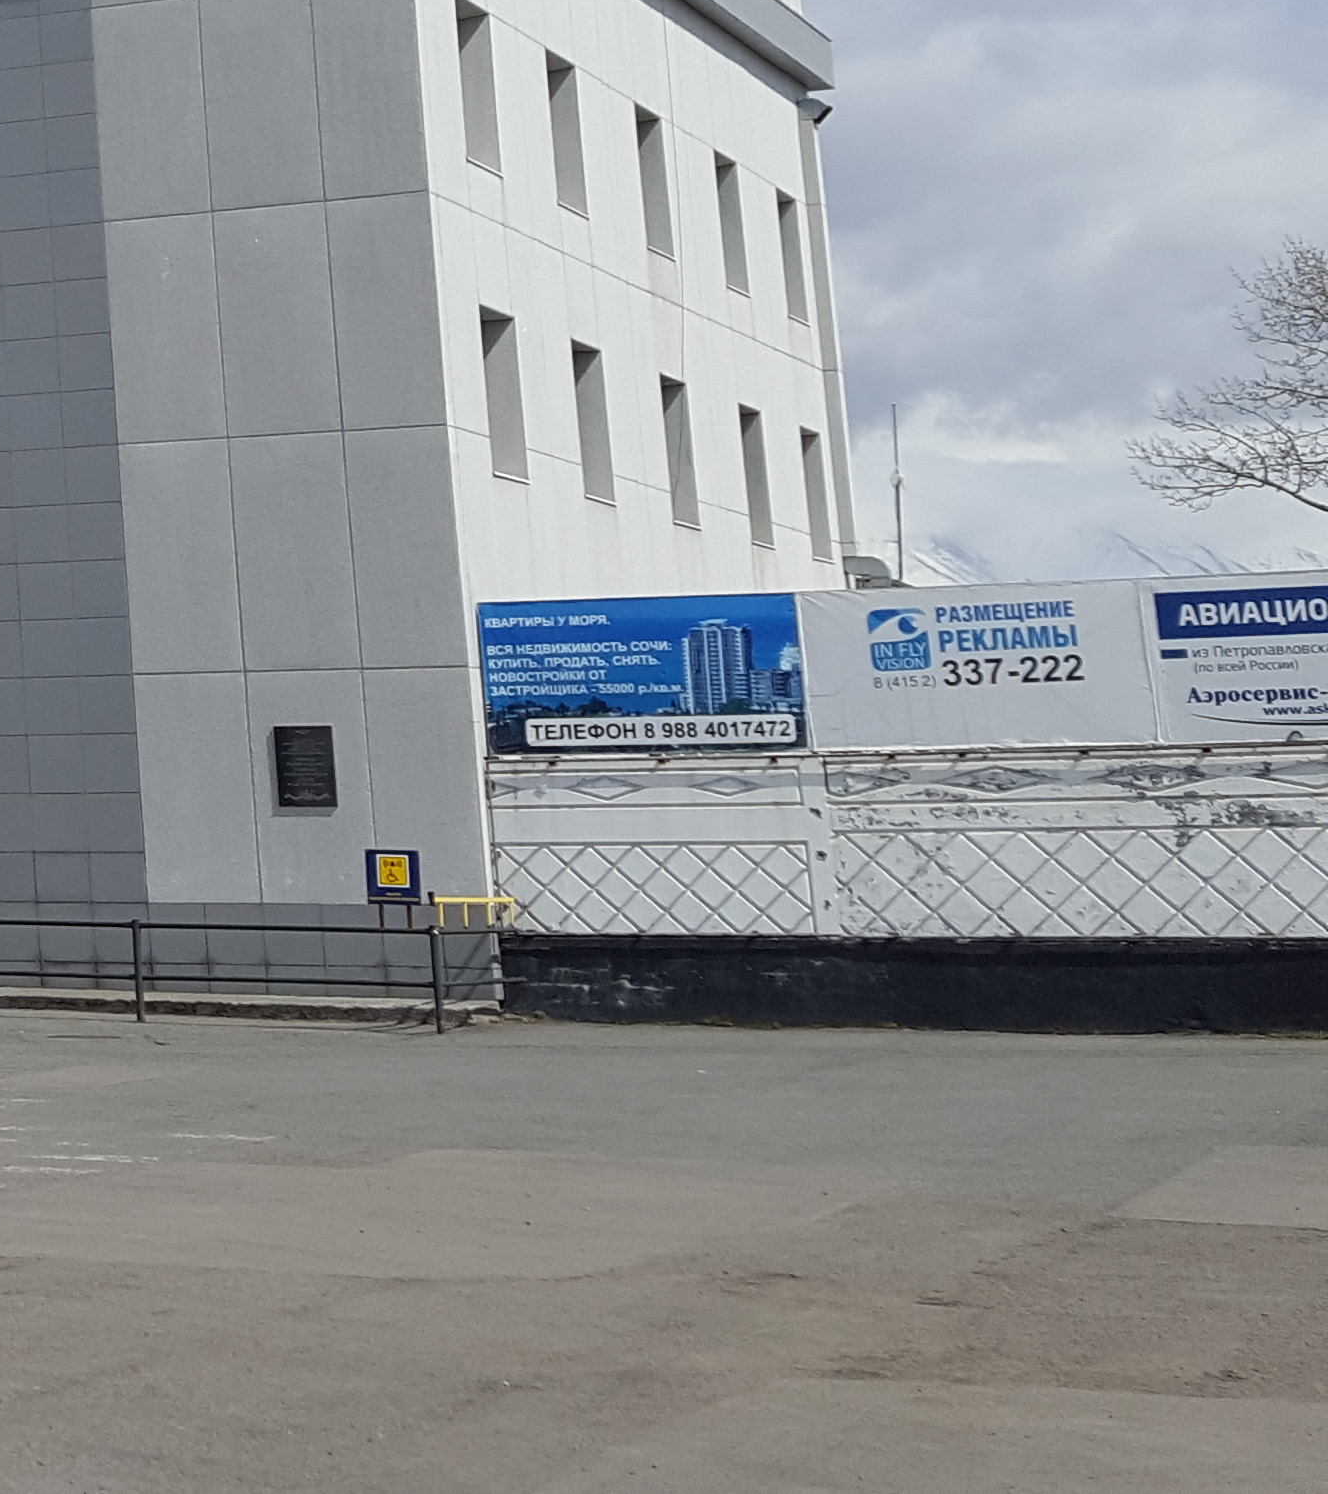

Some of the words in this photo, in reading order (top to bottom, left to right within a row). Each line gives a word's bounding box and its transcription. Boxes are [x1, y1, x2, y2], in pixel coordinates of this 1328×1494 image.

[935, 600, 1075, 624] РАЗМЕЩЕНИЕ
[484, 617, 555, 629] КВАРТИРЫ
[557, 617, 566, 627] У
[569, 614, 611, 626] МОРЯ.
[938, 624, 1079, 653] РЕКЛАМЫ
[486, 644, 513, 656] ВСЯ
[516, 641, 627, 655] НЕДВИЖИМОСТЬ
[630, 640, 673, 653] СОЧИ:
[874, 643, 894, 657] IN
[899, 640, 926, 656] FLY
[1192, 649, 1208, 658] из
[873, 677, 884, 689] 8
[942, 654, 1085, 687] 337-222
[875, 657, 925, 670] VISION
[1194, 661, 1213, 675] (по
[1217, 660, 1246, 672] всей
[1250, 658, 1299, 671] России)
[489, 671, 586, 683] НОВОСТРОЙКИ
[588, 669, 607, 680] ОТ
[490, 684, 589, 698] ЗАСТРОЙЩИКА
[1187, 686, 1328, 706] Аэросервис-
[531, 723, 637, 741] ТЕЛЕФОН
[644, 722, 655, 738] 8
[661, 721, 697, 738] 988
[704, 719, 791, 738] 4017472
